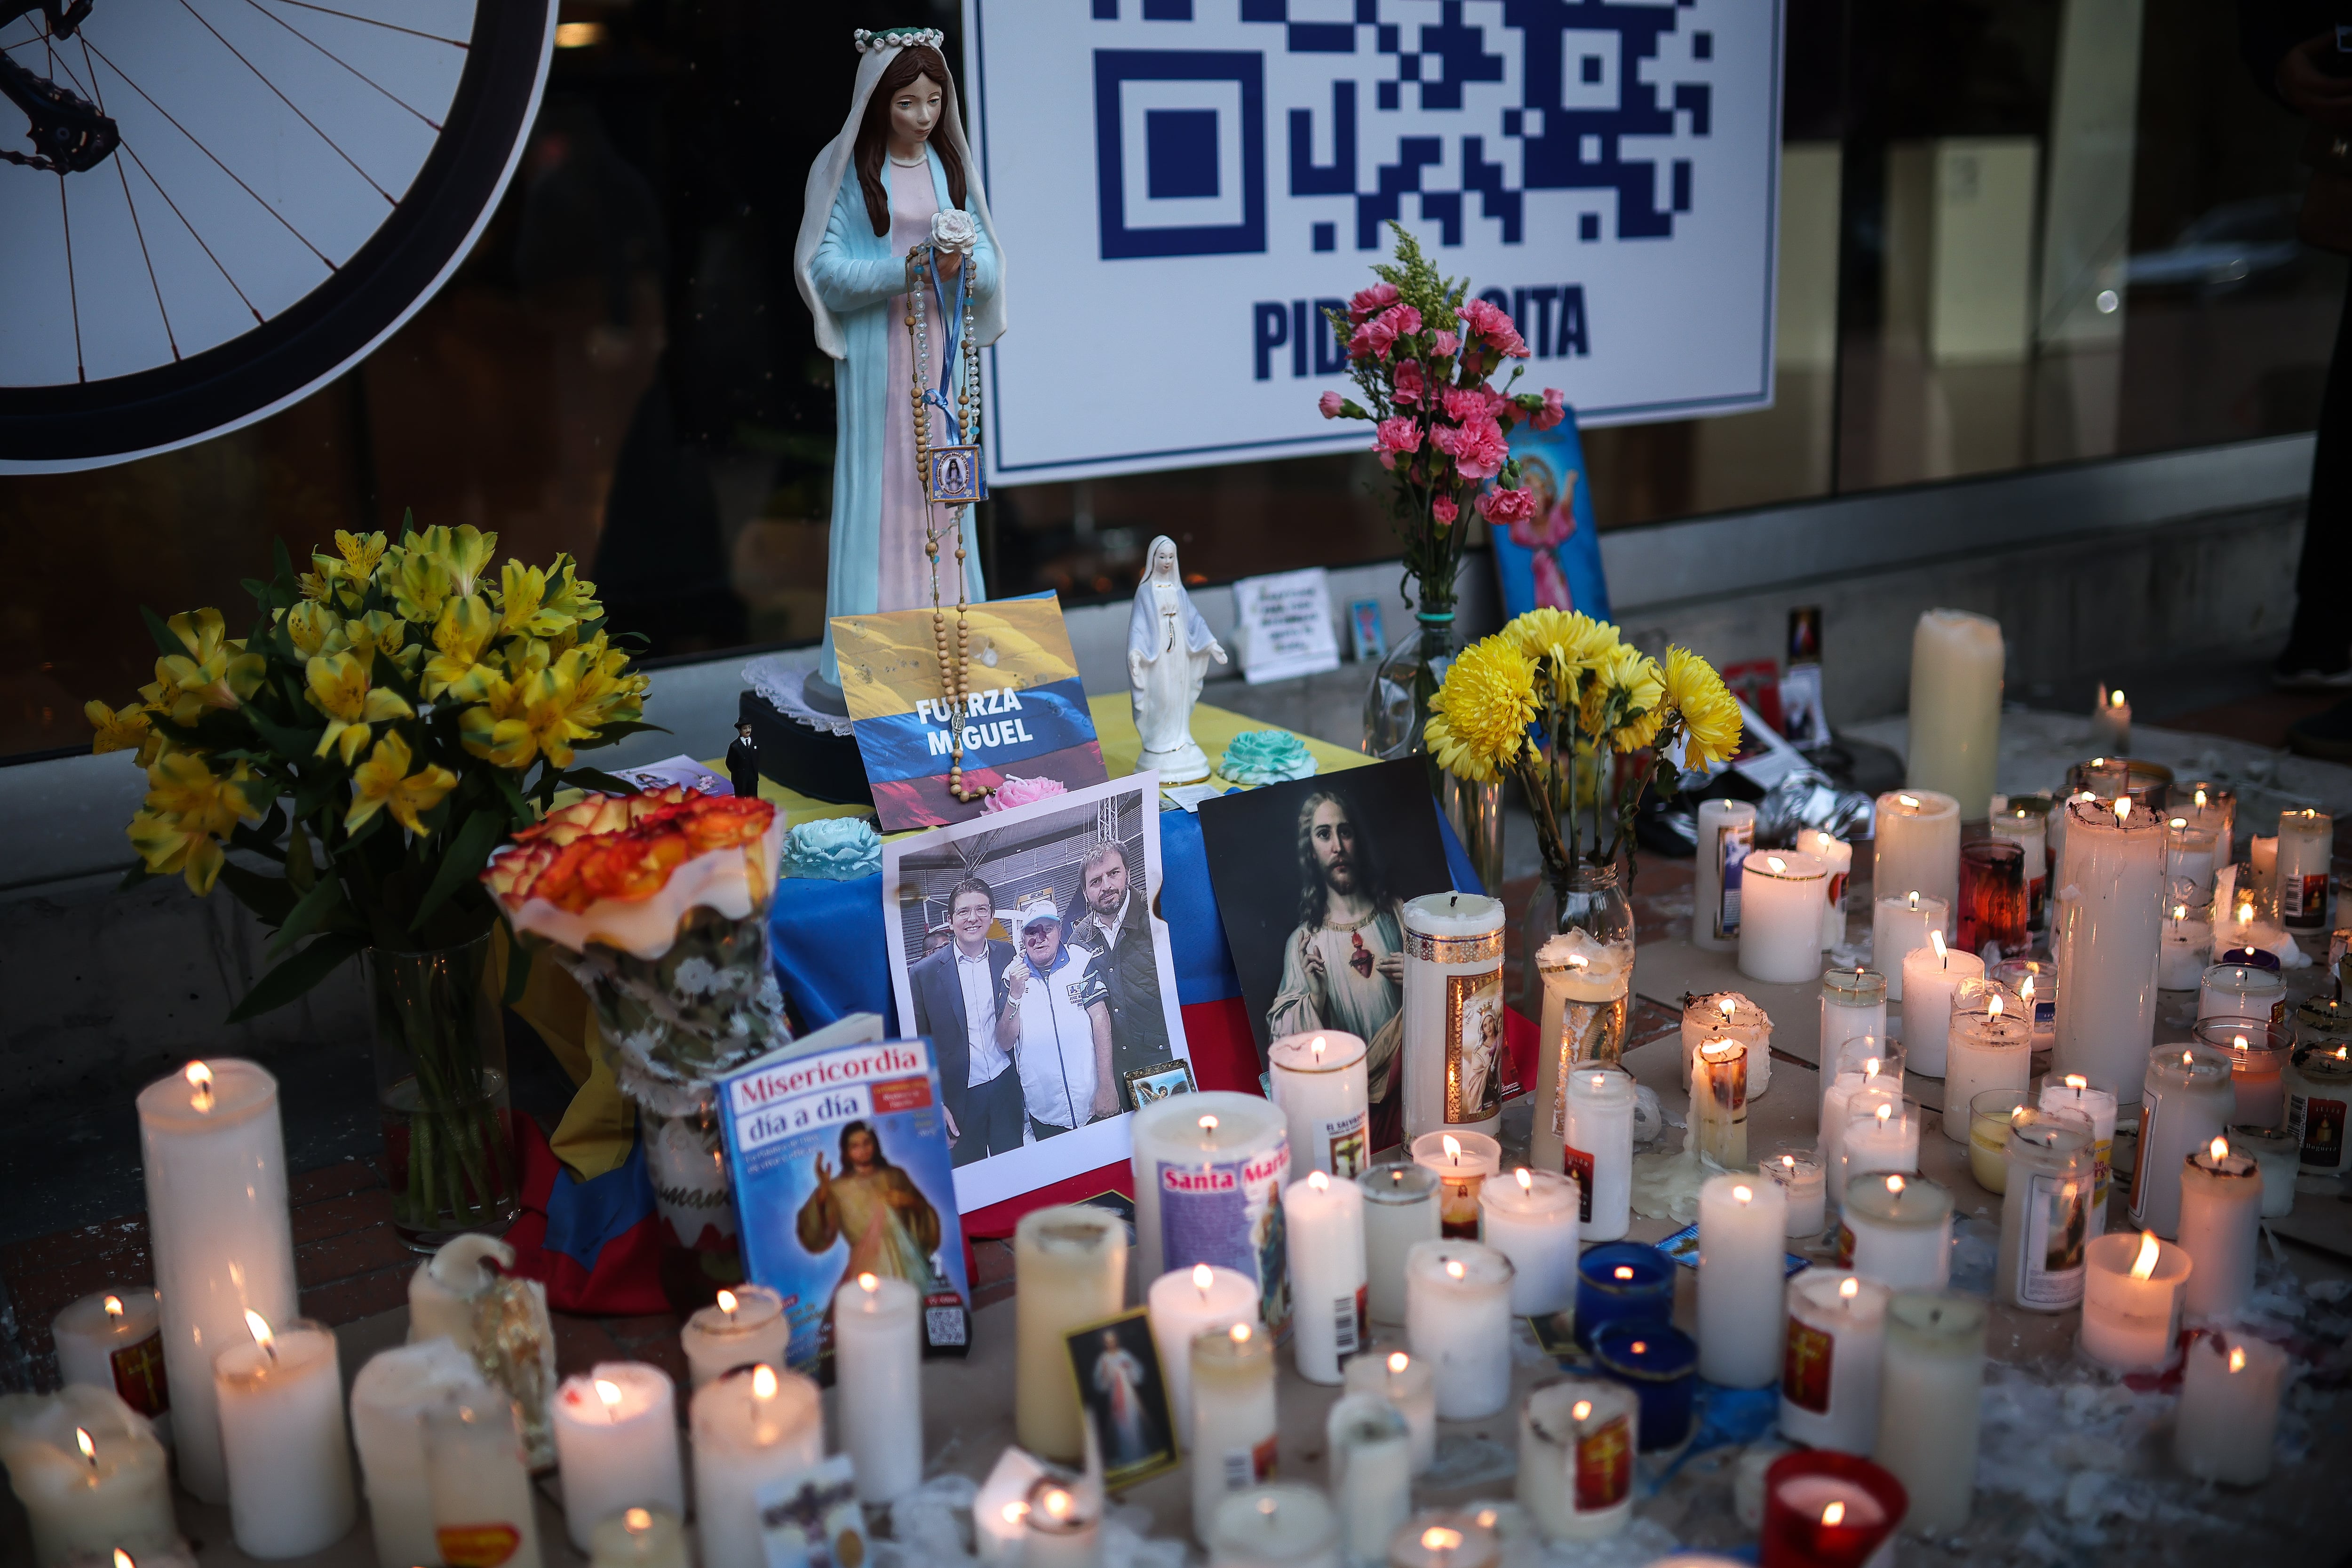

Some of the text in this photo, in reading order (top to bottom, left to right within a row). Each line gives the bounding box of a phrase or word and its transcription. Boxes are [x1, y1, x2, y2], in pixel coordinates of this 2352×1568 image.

[1254, 298, 1376, 380] PID
[741, 1048, 917, 1107] Misericordia
[795, 1109, 810, 1128] a
[1165, 1170, 1234, 1190] Santa
